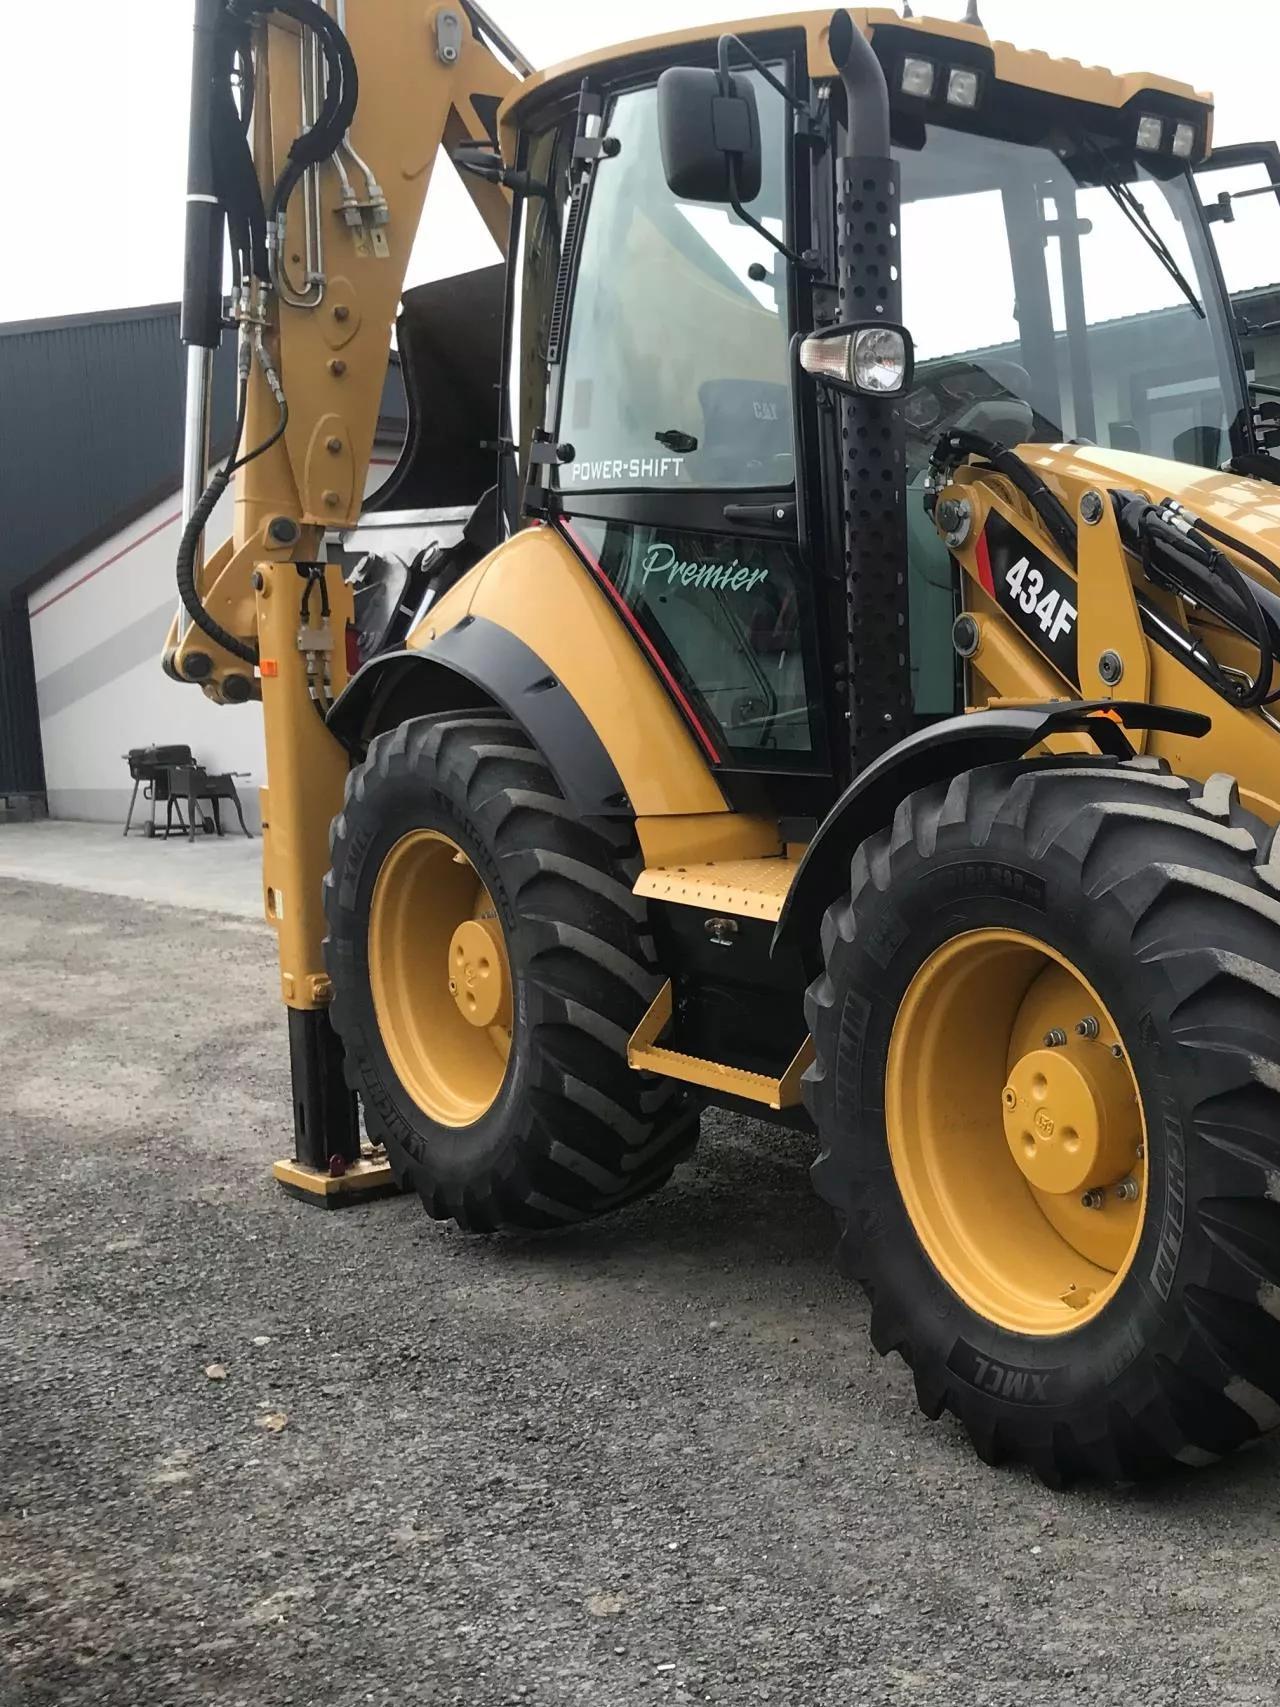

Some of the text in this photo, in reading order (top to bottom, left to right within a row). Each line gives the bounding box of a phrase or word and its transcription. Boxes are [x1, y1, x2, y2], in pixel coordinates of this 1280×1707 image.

[572, 458, 683, 481] POWER-SHIFT
[641, 543, 769, 592] Premier
[1005, 556, 1078, 642] 434F
[973, 1356, 1050, 1401] XMCL
